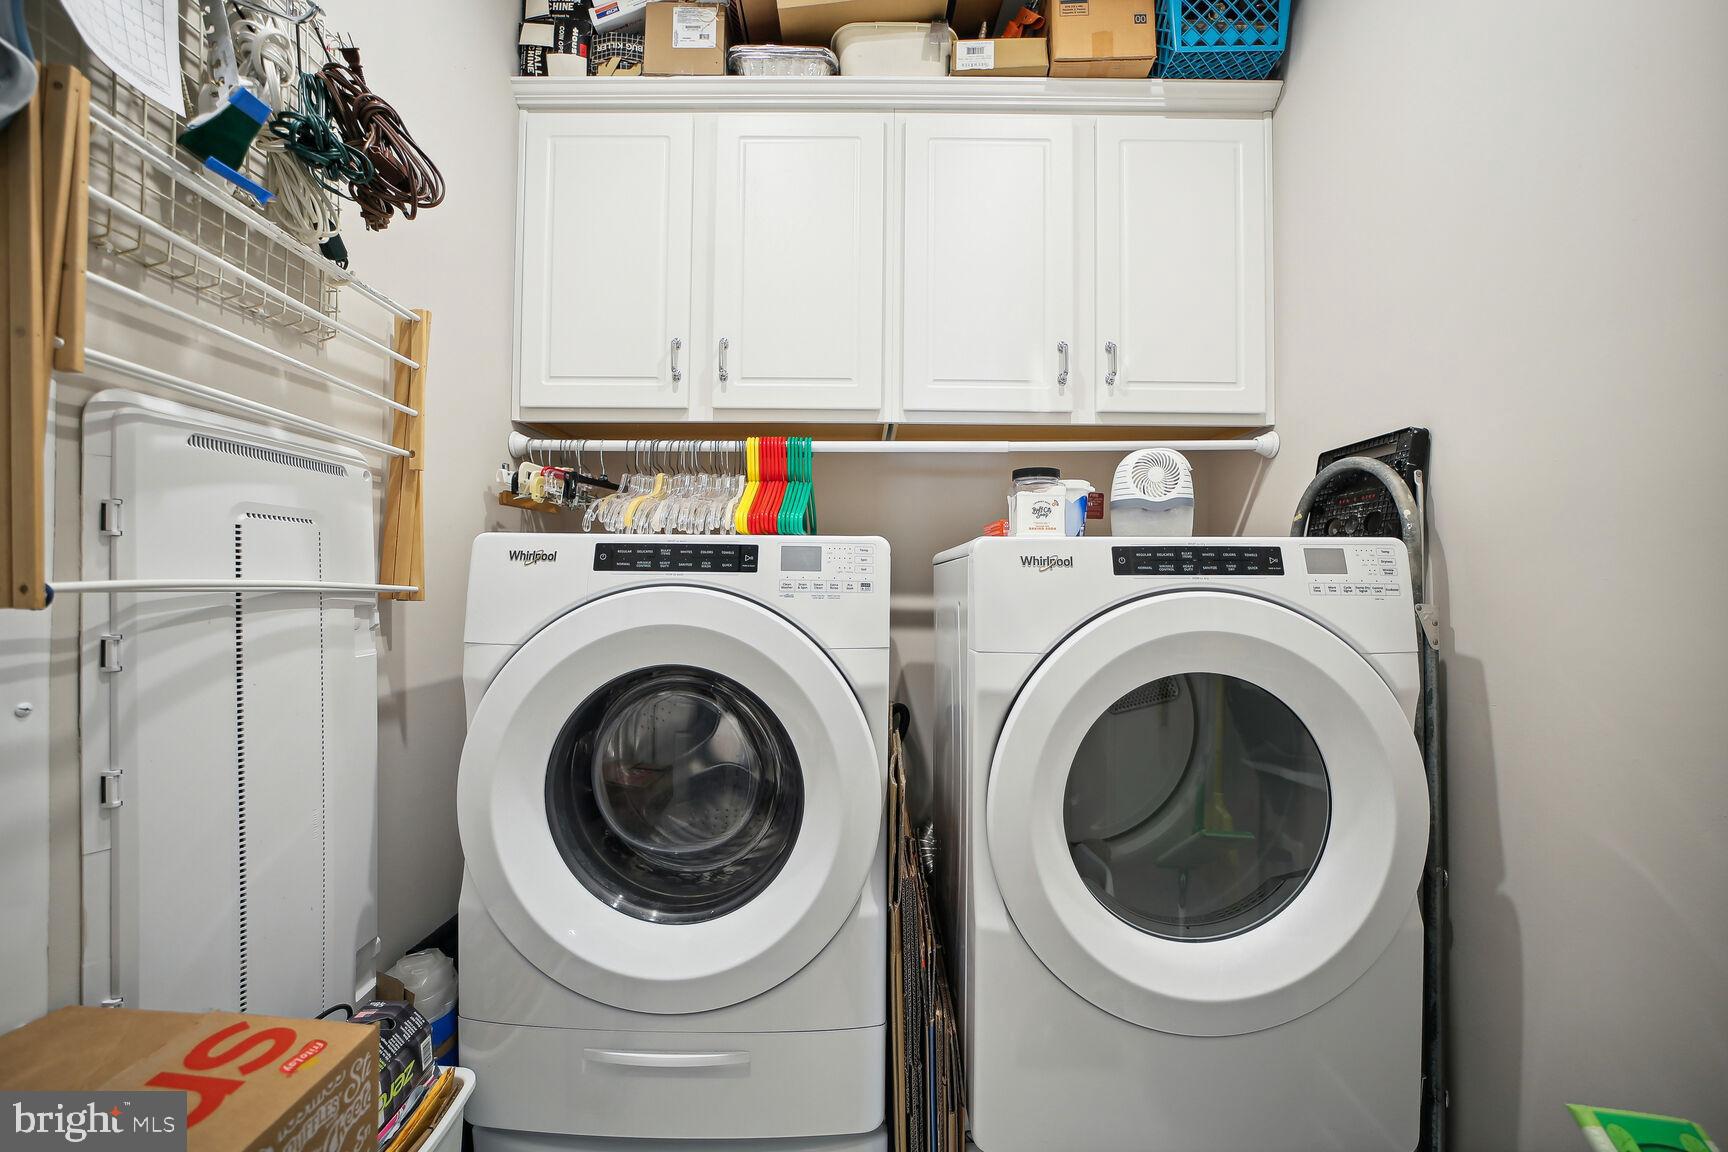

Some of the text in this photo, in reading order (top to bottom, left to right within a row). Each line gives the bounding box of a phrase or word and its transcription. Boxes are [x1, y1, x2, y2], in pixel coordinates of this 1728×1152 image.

[596, 41, 643, 52] BUG KILLER
[509, 550, 557, 565] Whirlpool
[1020, 555, 1073, 572] Whirlpool
